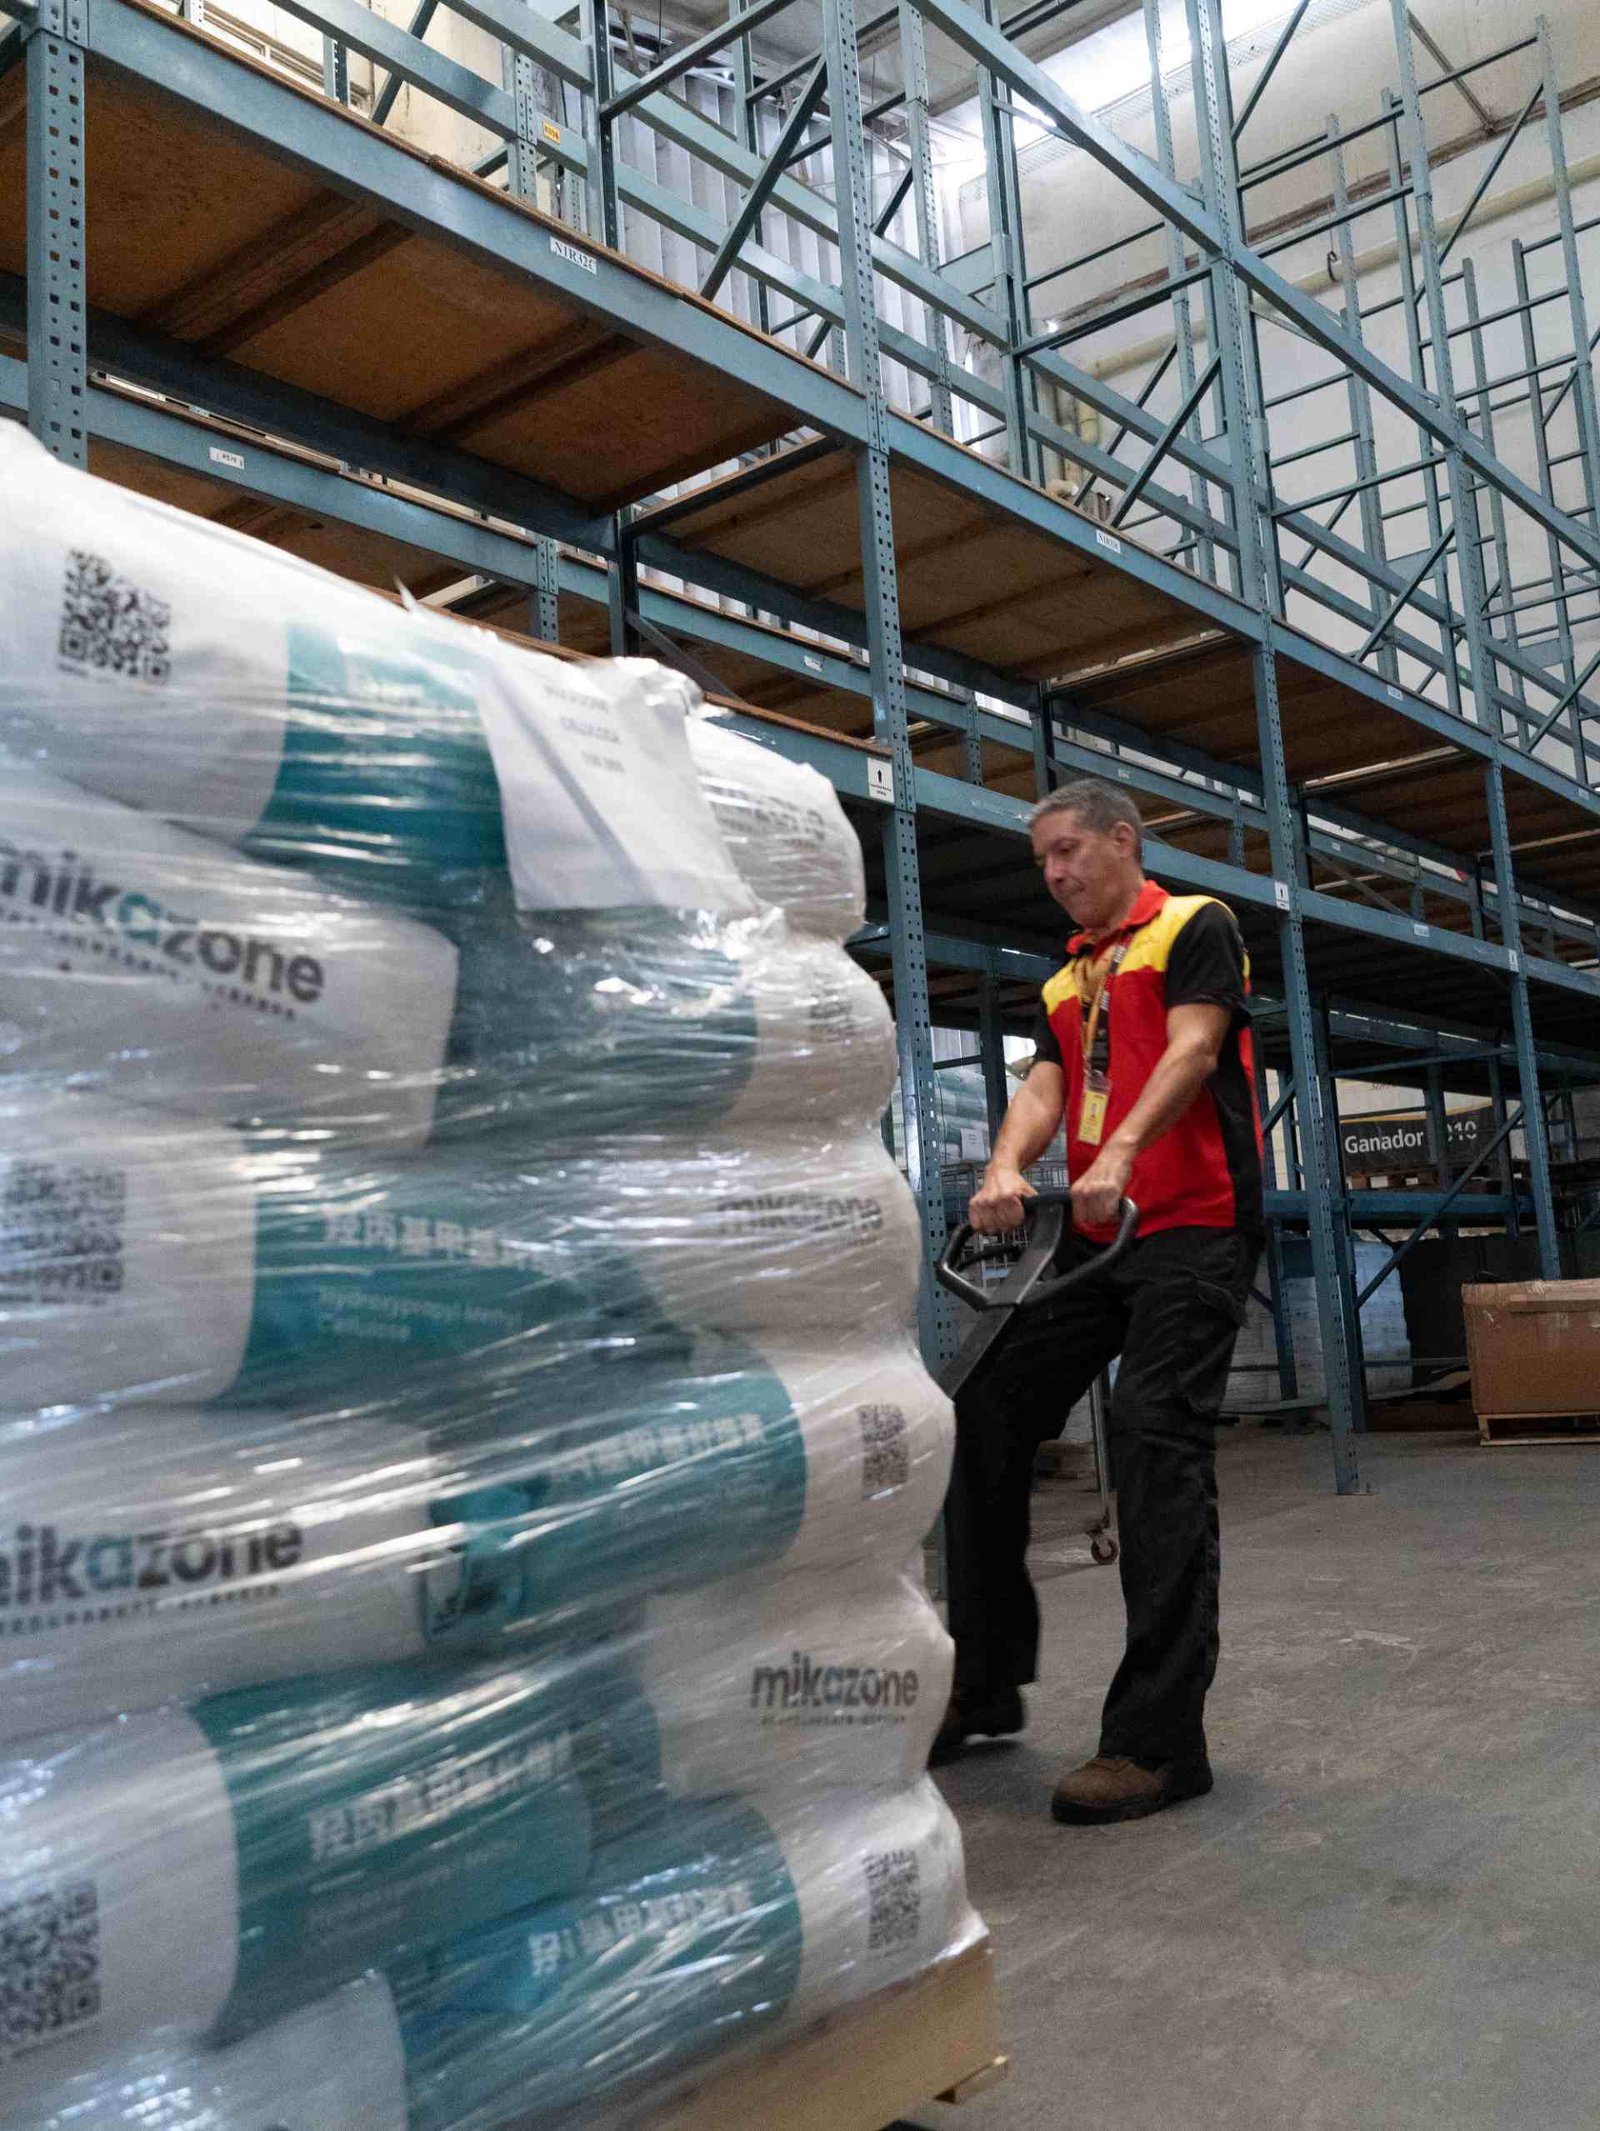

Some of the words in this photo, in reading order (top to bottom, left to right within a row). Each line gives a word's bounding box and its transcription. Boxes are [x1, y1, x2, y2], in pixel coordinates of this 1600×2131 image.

[1344, 1129, 1424, 1154] Ganador
[0, 1522, 302, 1604] ikazone
[752, 1651, 919, 1709] mikazone
